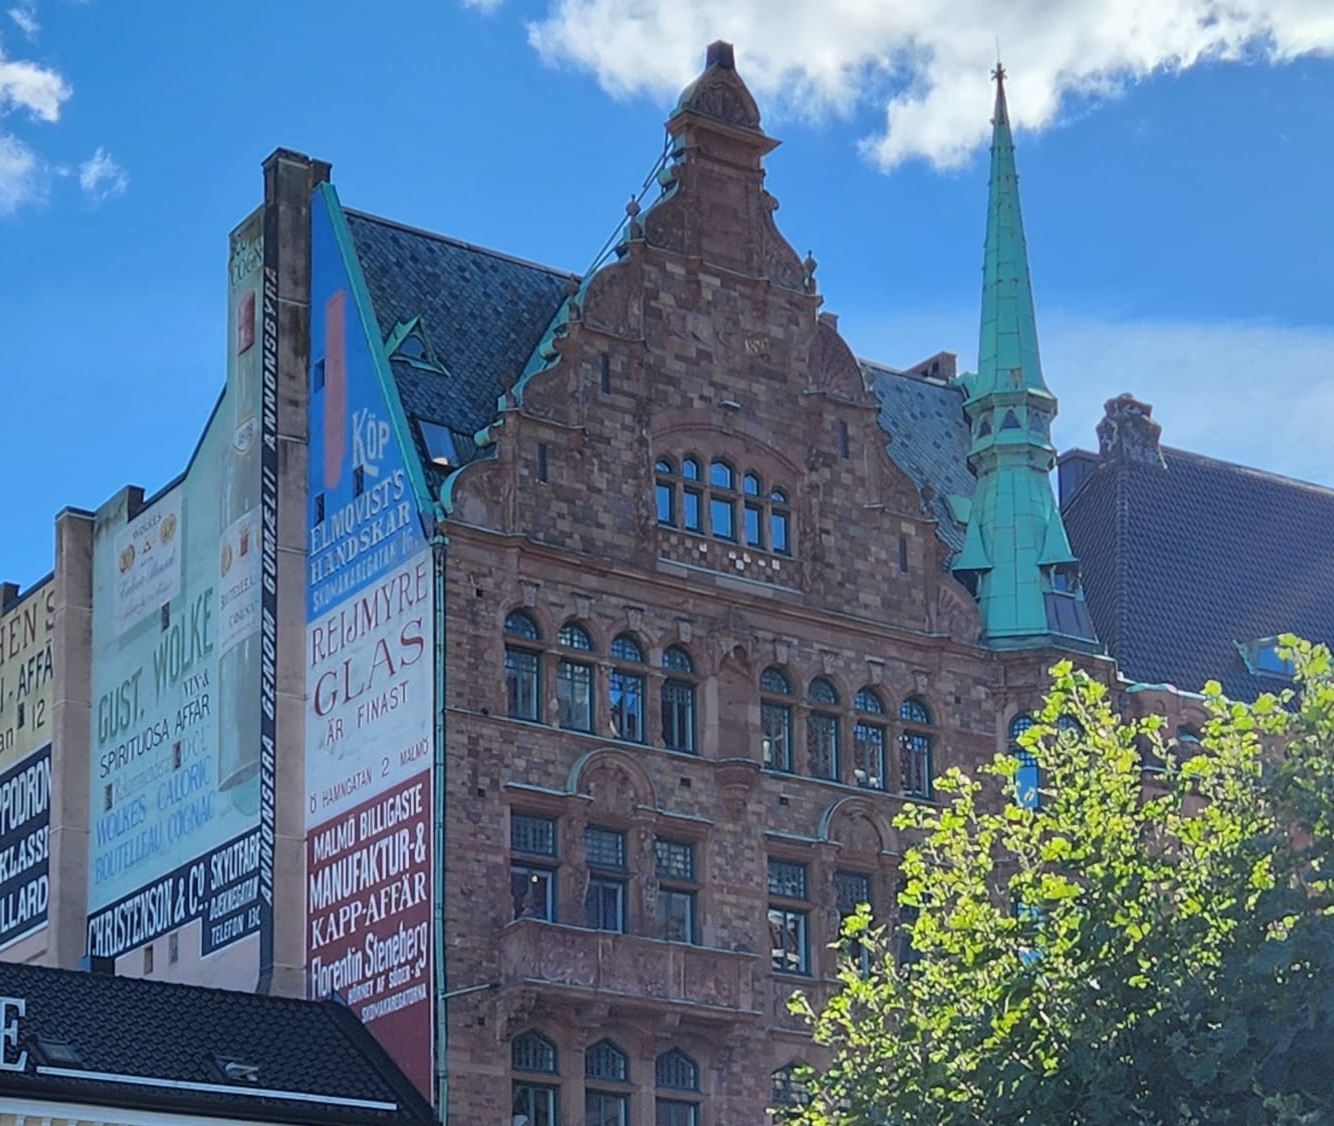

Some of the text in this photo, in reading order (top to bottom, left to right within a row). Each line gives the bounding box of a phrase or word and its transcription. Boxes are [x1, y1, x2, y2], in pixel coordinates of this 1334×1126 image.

[310, 502, 411, 586] HANDSKAR
[311, 561, 428, 667] REIJMYRE
[98, 666, 144, 744] GUST.
[153, 586, 213, 706] WOLKE
[261, 608, 276, 720] GENOM
[314, 616, 424, 717] GLAS
[32, 698, 45, 731] 12
[99, 718, 170, 778] SPIRITUOSA
[174, 692, 210, 735] AFFÄR
[326, 680, 409, 746] ÄR FINAST
[96, 793, 148, 848] WOLKES
[157, 755, 212, 812] CALORIC
[323, 767, 372, 808] HAMNGATAN
[381, 757, 389, 778] 2
[400, 736, 429, 766] MALMÖ
[260, 736, 274, 907] ANNONSERA
[314, 783, 423, 864] MALMÖ BILLIGASTE
[88, 877, 173, 958] CHRISTENSON
[174, 877, 185, 923] &
[211, 914, 244, 946] TELEFON
[311, 872, 427, 950] KAPP-AFFÄR
[311, 920, 427, 1000] Florentin Steneberg
